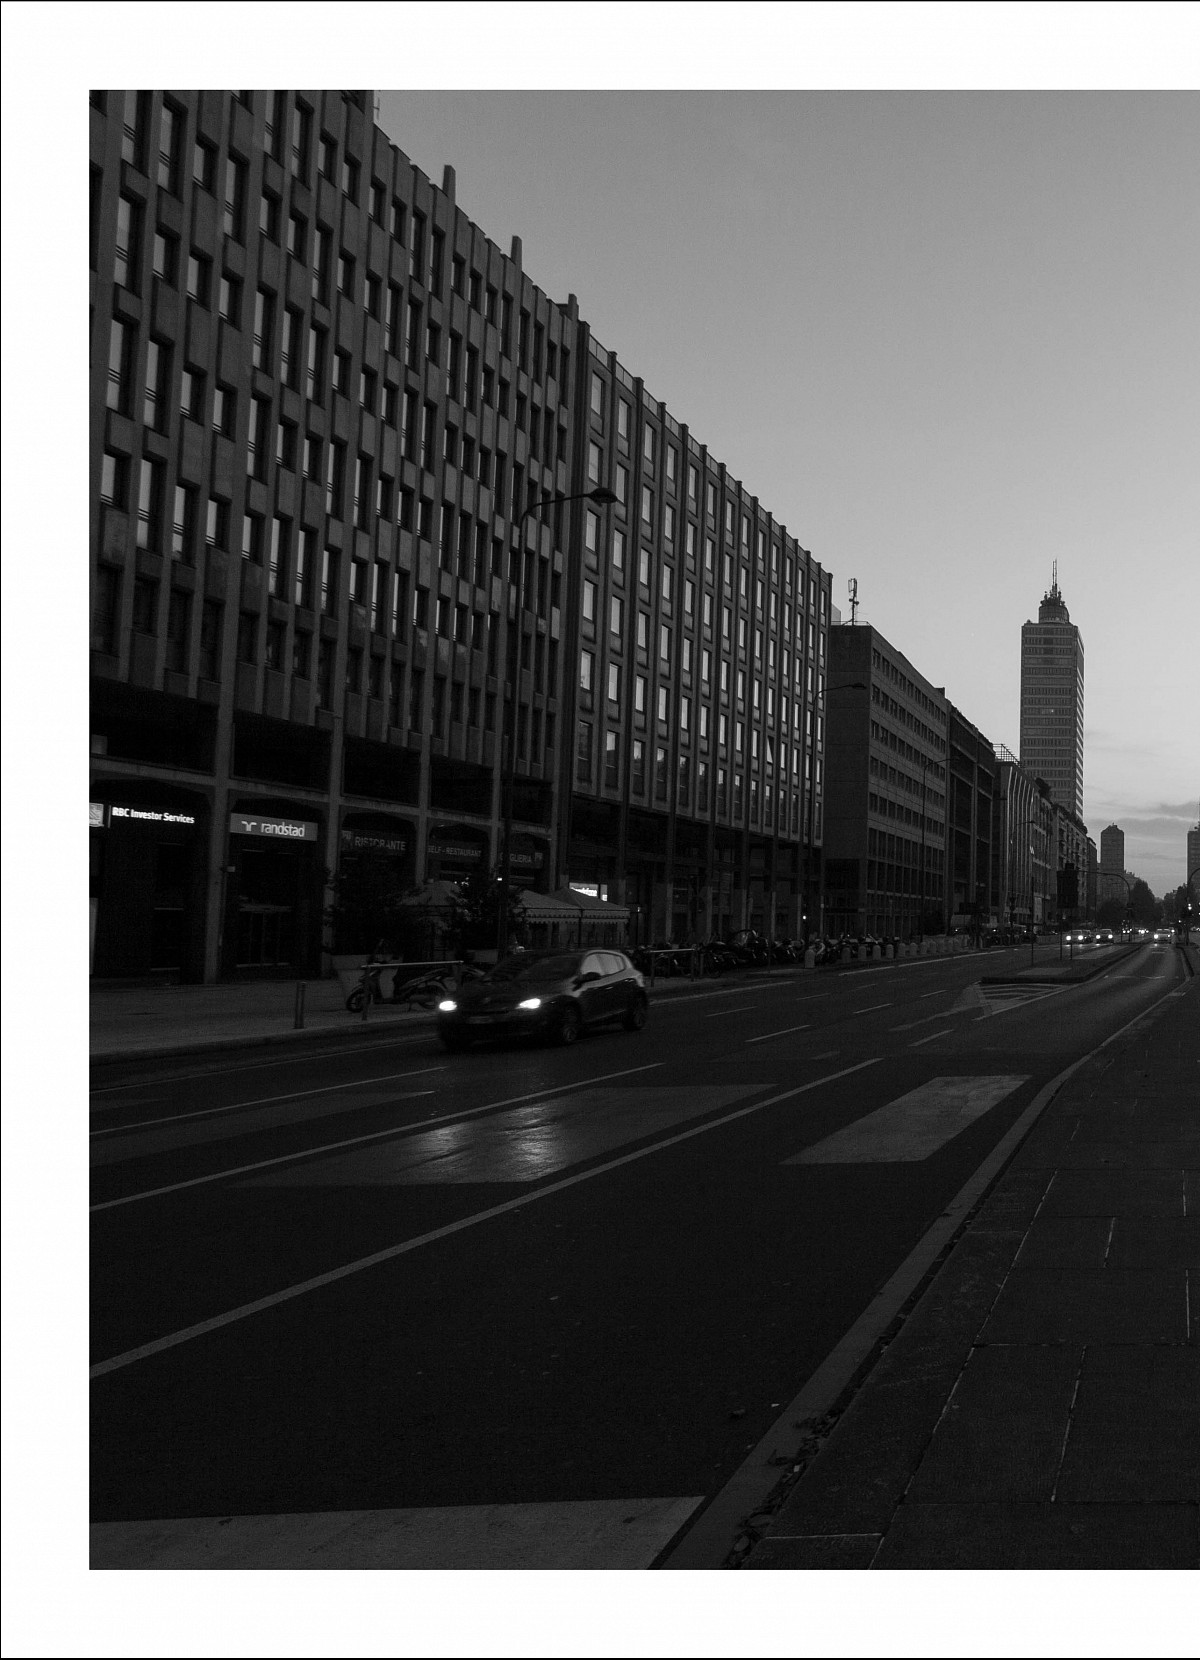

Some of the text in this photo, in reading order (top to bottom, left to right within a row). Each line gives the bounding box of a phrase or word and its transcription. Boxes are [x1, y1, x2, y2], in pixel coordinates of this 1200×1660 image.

[112, 806, 196, 824] RBC Investor Services
[260, 821, 306, 838] randstad
[354, 836, 408, 851] RISTORANTE
